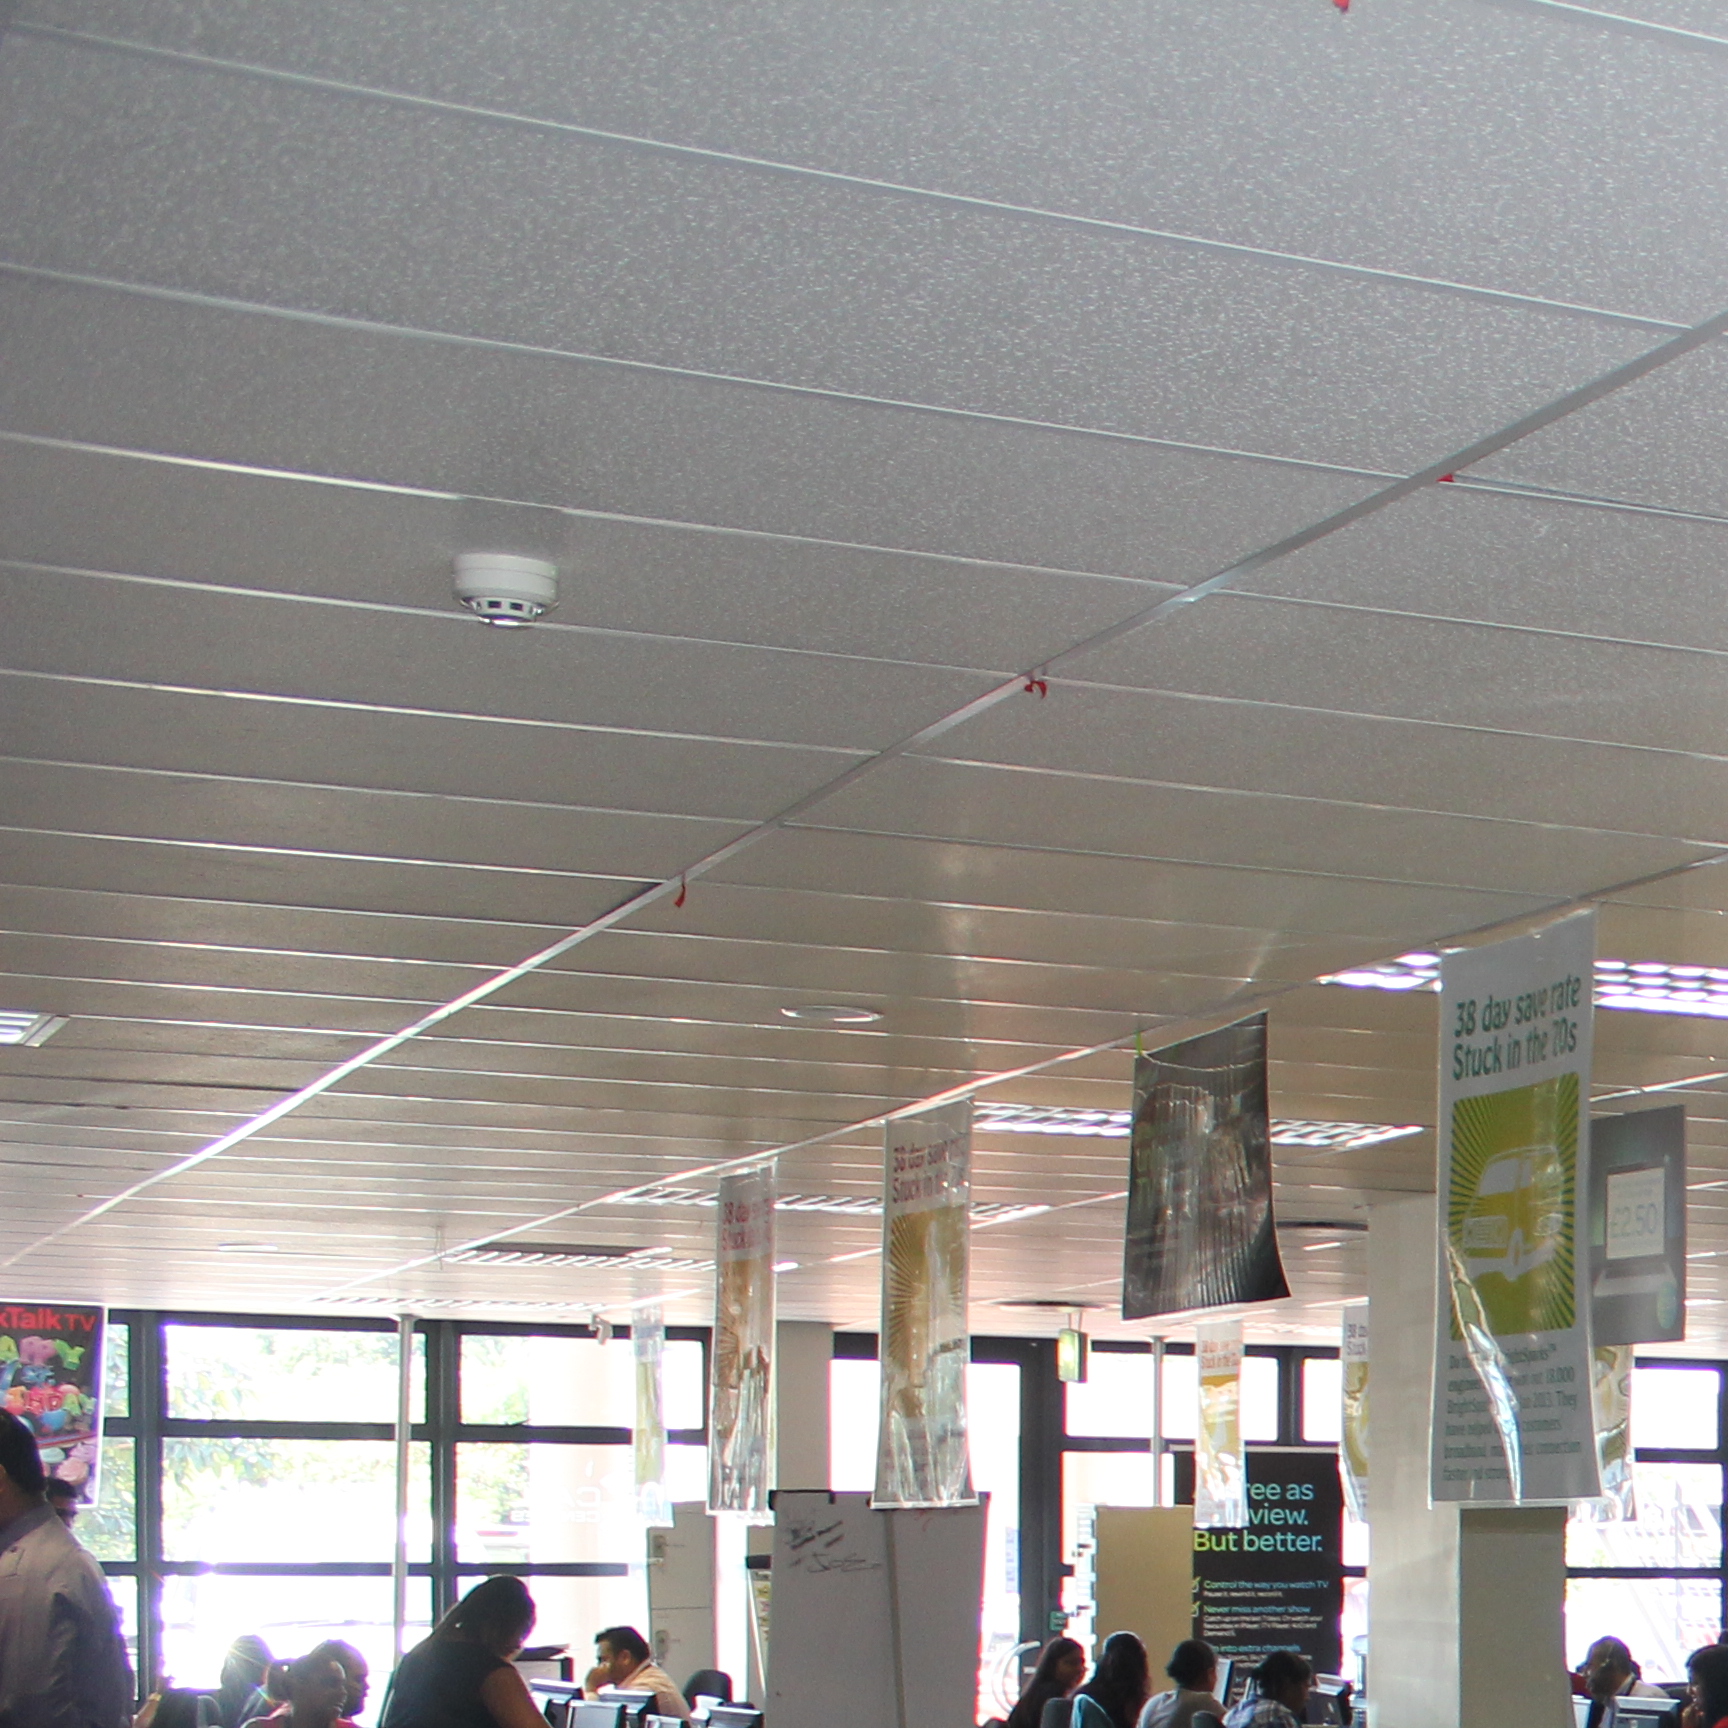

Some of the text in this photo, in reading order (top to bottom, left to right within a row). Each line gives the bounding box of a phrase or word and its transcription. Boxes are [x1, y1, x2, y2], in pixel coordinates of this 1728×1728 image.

[1453, 973, 1581, 1037] 38 day save rate
[1452, 1016, 1578, 1081] Stuck in the 70s
[65, 1313, 96, 1332] TV
[1285, 1482, 1314, 1501] as
[1193, 1529, 1323, 1552] But better.
[1316, 1579, 1330, 1589] TV
